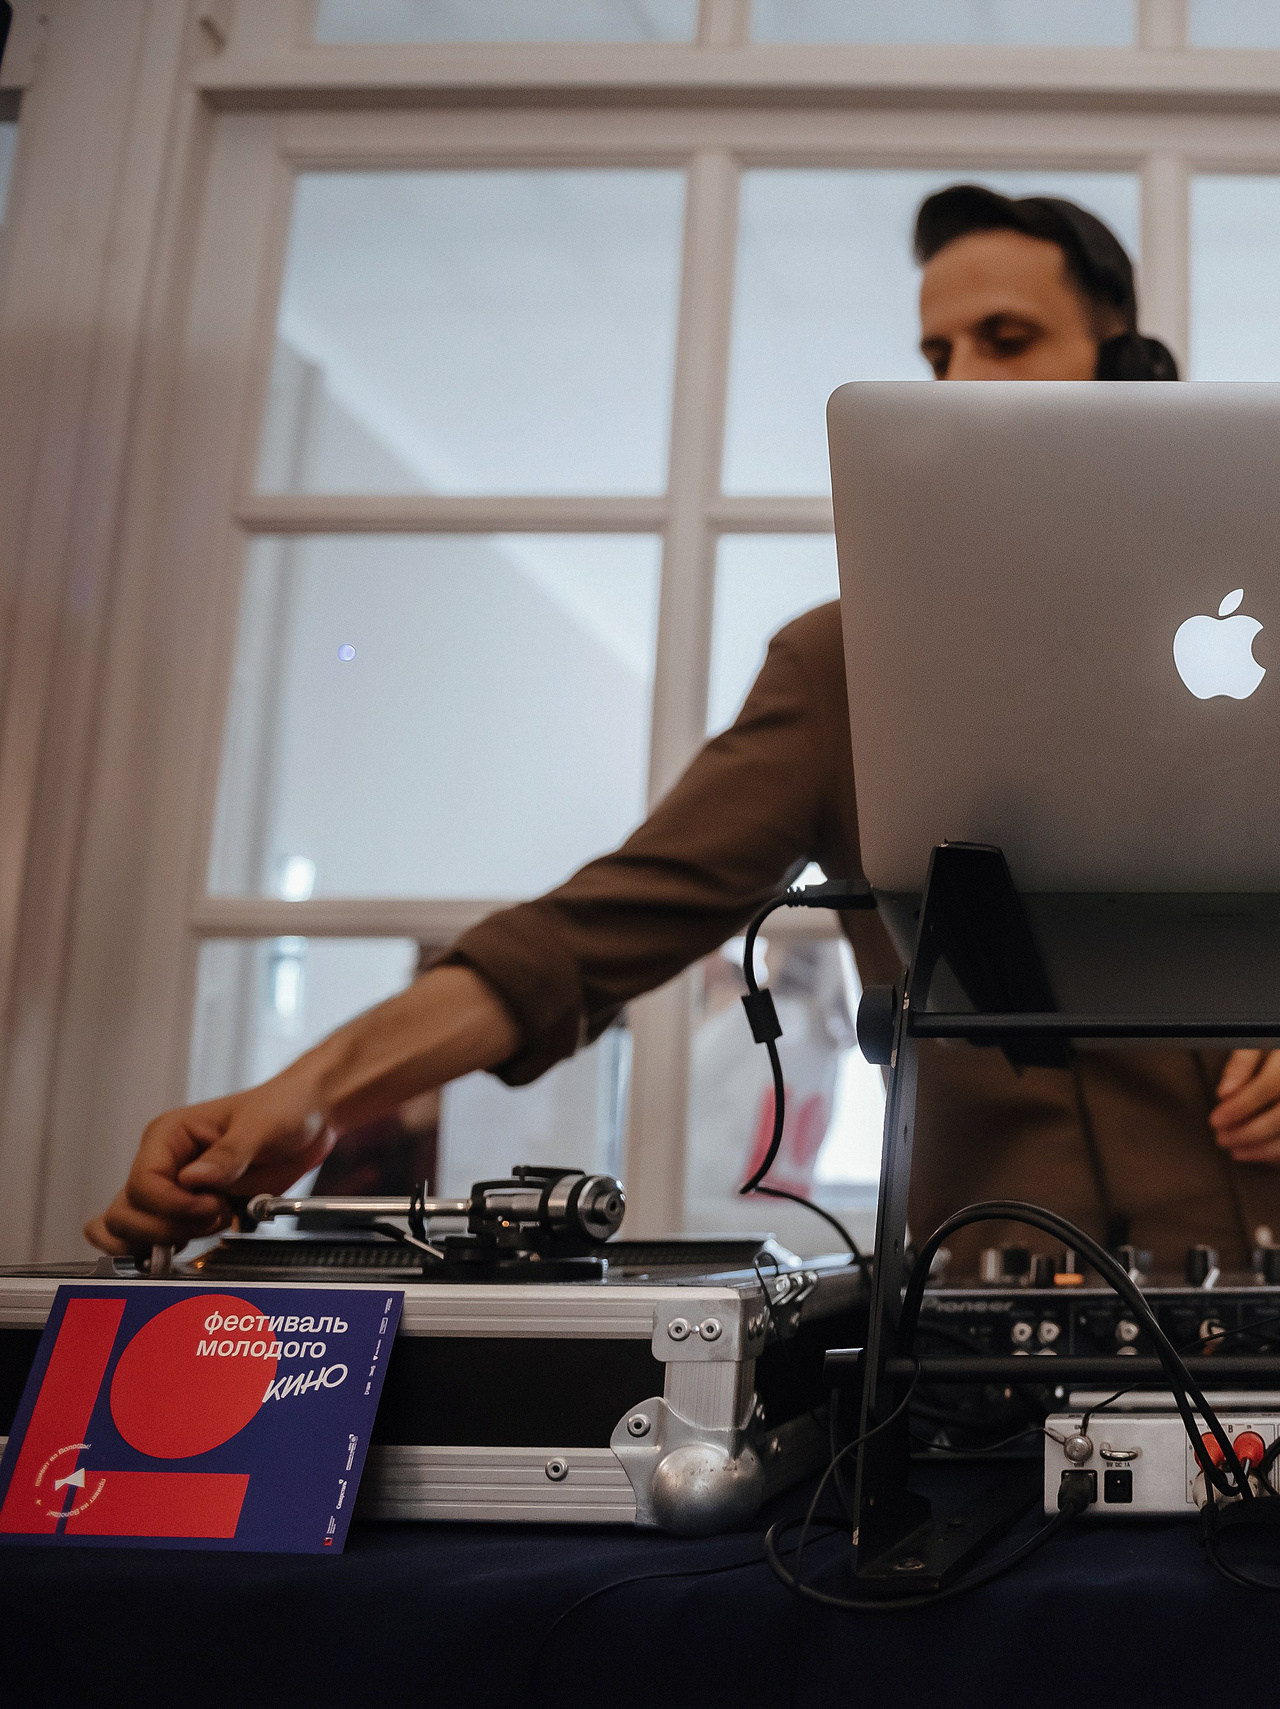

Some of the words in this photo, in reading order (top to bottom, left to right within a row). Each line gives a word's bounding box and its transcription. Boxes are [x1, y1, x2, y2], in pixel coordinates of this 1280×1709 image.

[203, 1310, 349, 1336] фестиваль
[196, 1338, 327, 1361] молодого
[1228, 1424, 1234, 1433] B
